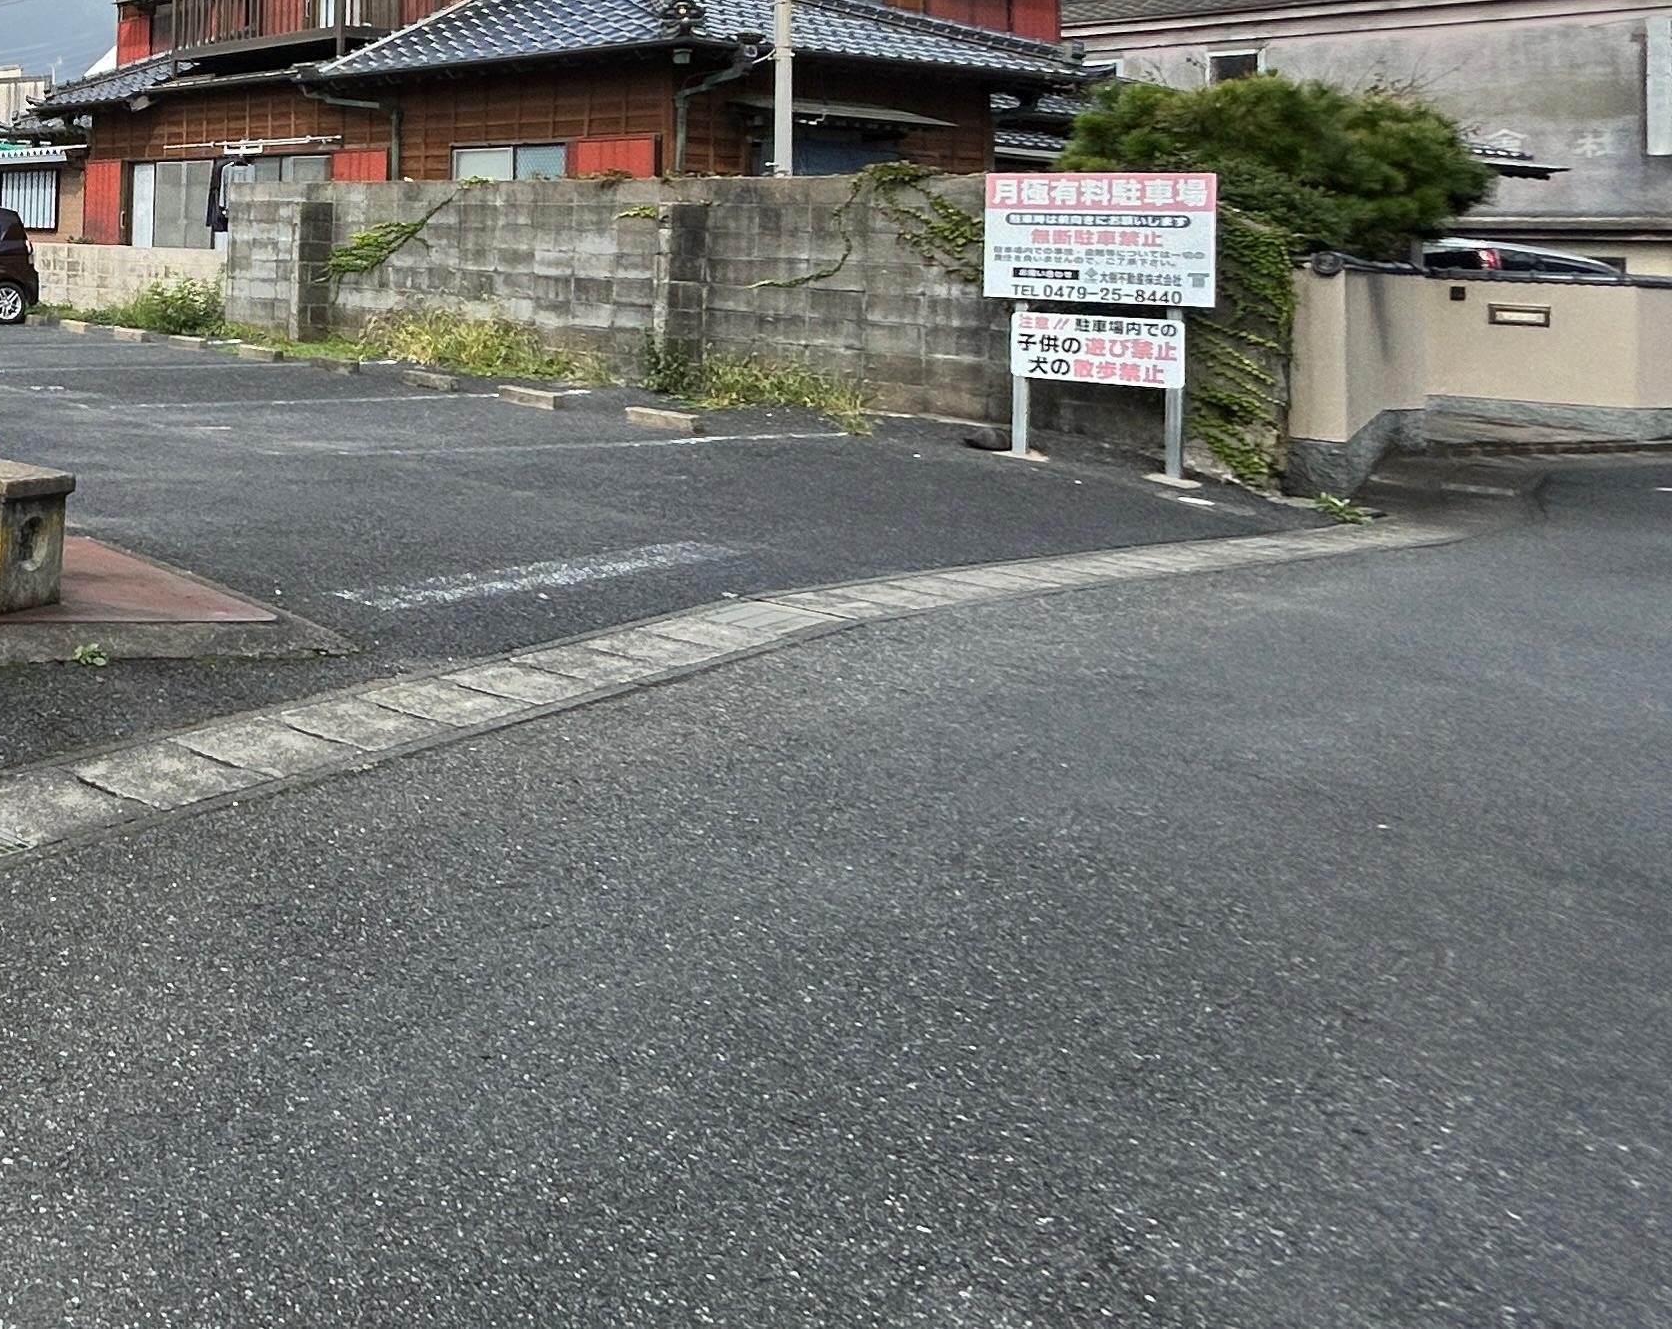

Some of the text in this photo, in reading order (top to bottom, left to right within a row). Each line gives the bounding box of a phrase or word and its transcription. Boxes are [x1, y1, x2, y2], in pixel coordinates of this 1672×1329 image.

[992, 178, 1208, 207] 月極有料駐車場
[1031, 229, 1164, 247] 無断駐車禁止
[1011, 284, 1183, 305] TEL 0479-25-8440
[1074, 318, 1177, 337] 駐車場内での
[1017, 333, 1178, 362] 子供の遊び禁止
[1028, 355, 1165, 384] 犬の散歩禁止
